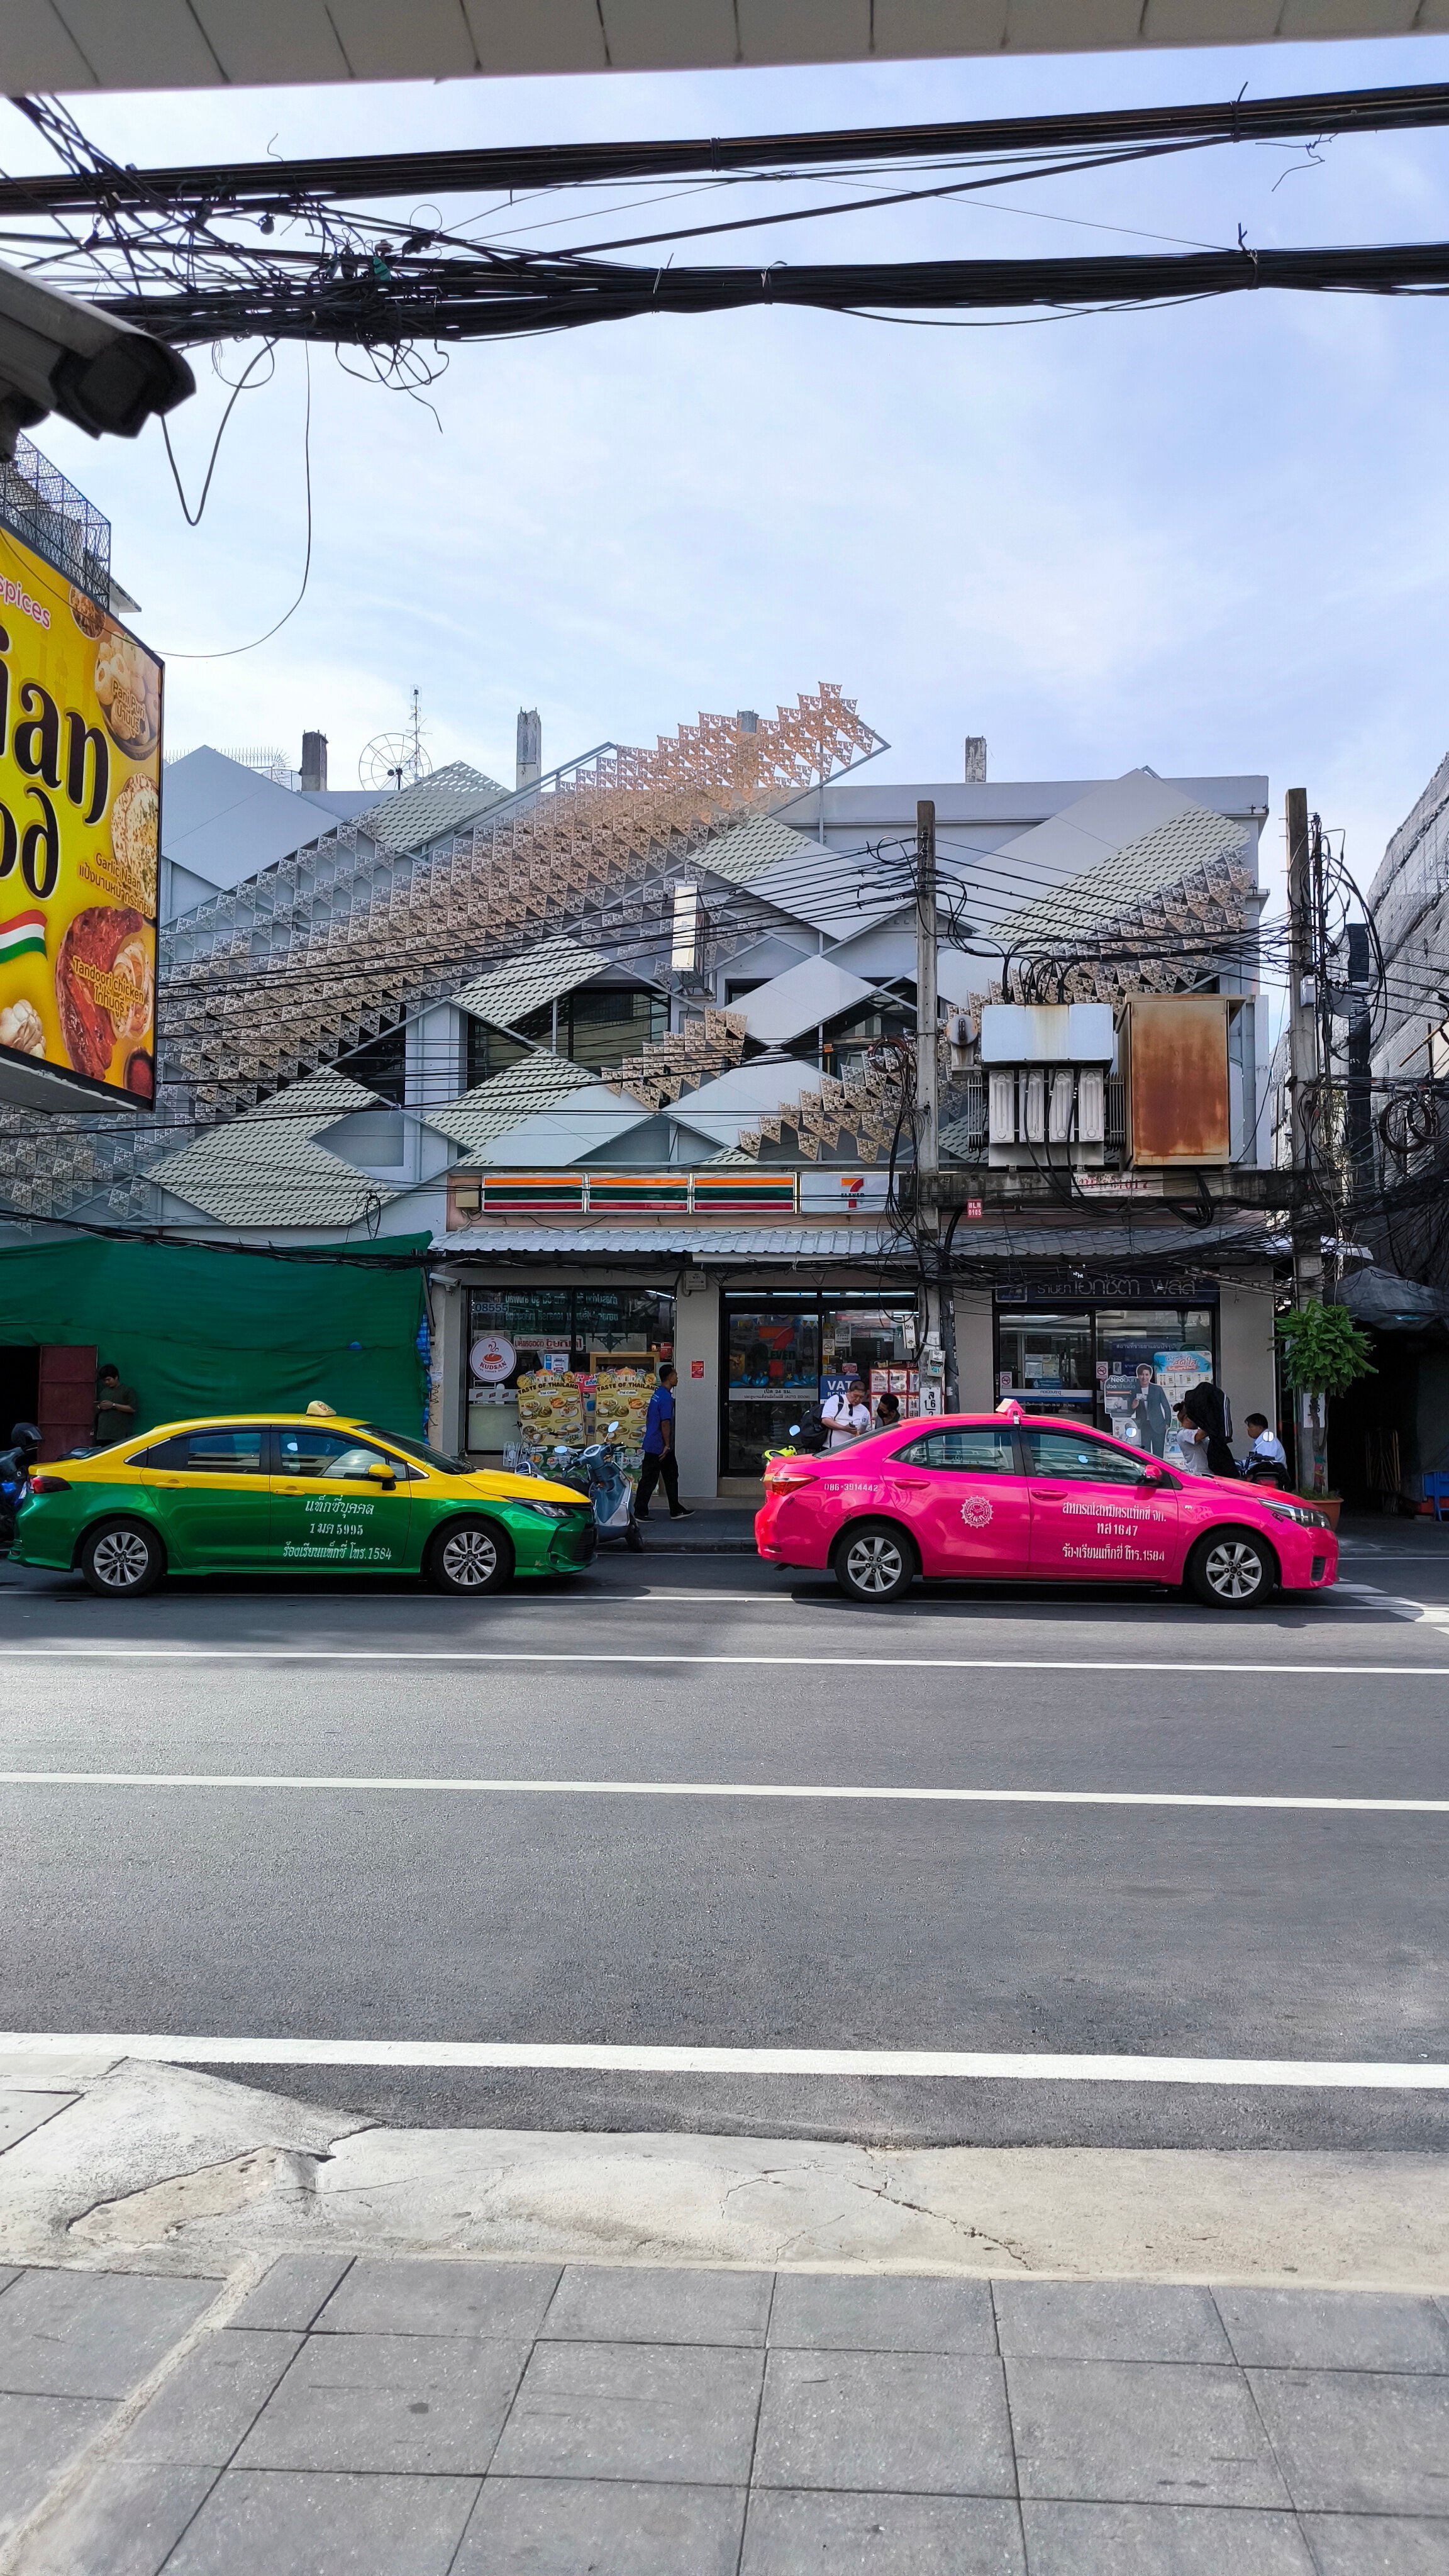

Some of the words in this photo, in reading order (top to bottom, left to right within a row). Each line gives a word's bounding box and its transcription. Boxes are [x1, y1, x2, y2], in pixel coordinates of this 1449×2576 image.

[113, 680, 130, 704] Pani
[131, 697, 145, 719] Puri
[96, 853, 120, 877] Garlic
[121, 869, 141, 891] Naan
[74, 958, 112, 989] Tandoori
[114, 979, 143, 1002] chicken
[475, 1303, 508, 1313] 08555
[479, 1360, 507, 1370] KUDSAN
[518, 1384, 536, 1394] TASTE
[827, 1380, 852, 1391] VAT
[305, 1495, 375, 1518] แท็กซี่บุคคล
[336, 1524, 364, 1535] 5995
[1114, 1524, 1138, 1536] 1647
[283, 1540, 348, 1558] ร้องเรียนแท็กซี่
[1062, 1543, 1123, 1559] ร้องเรียนแท็กซี่
